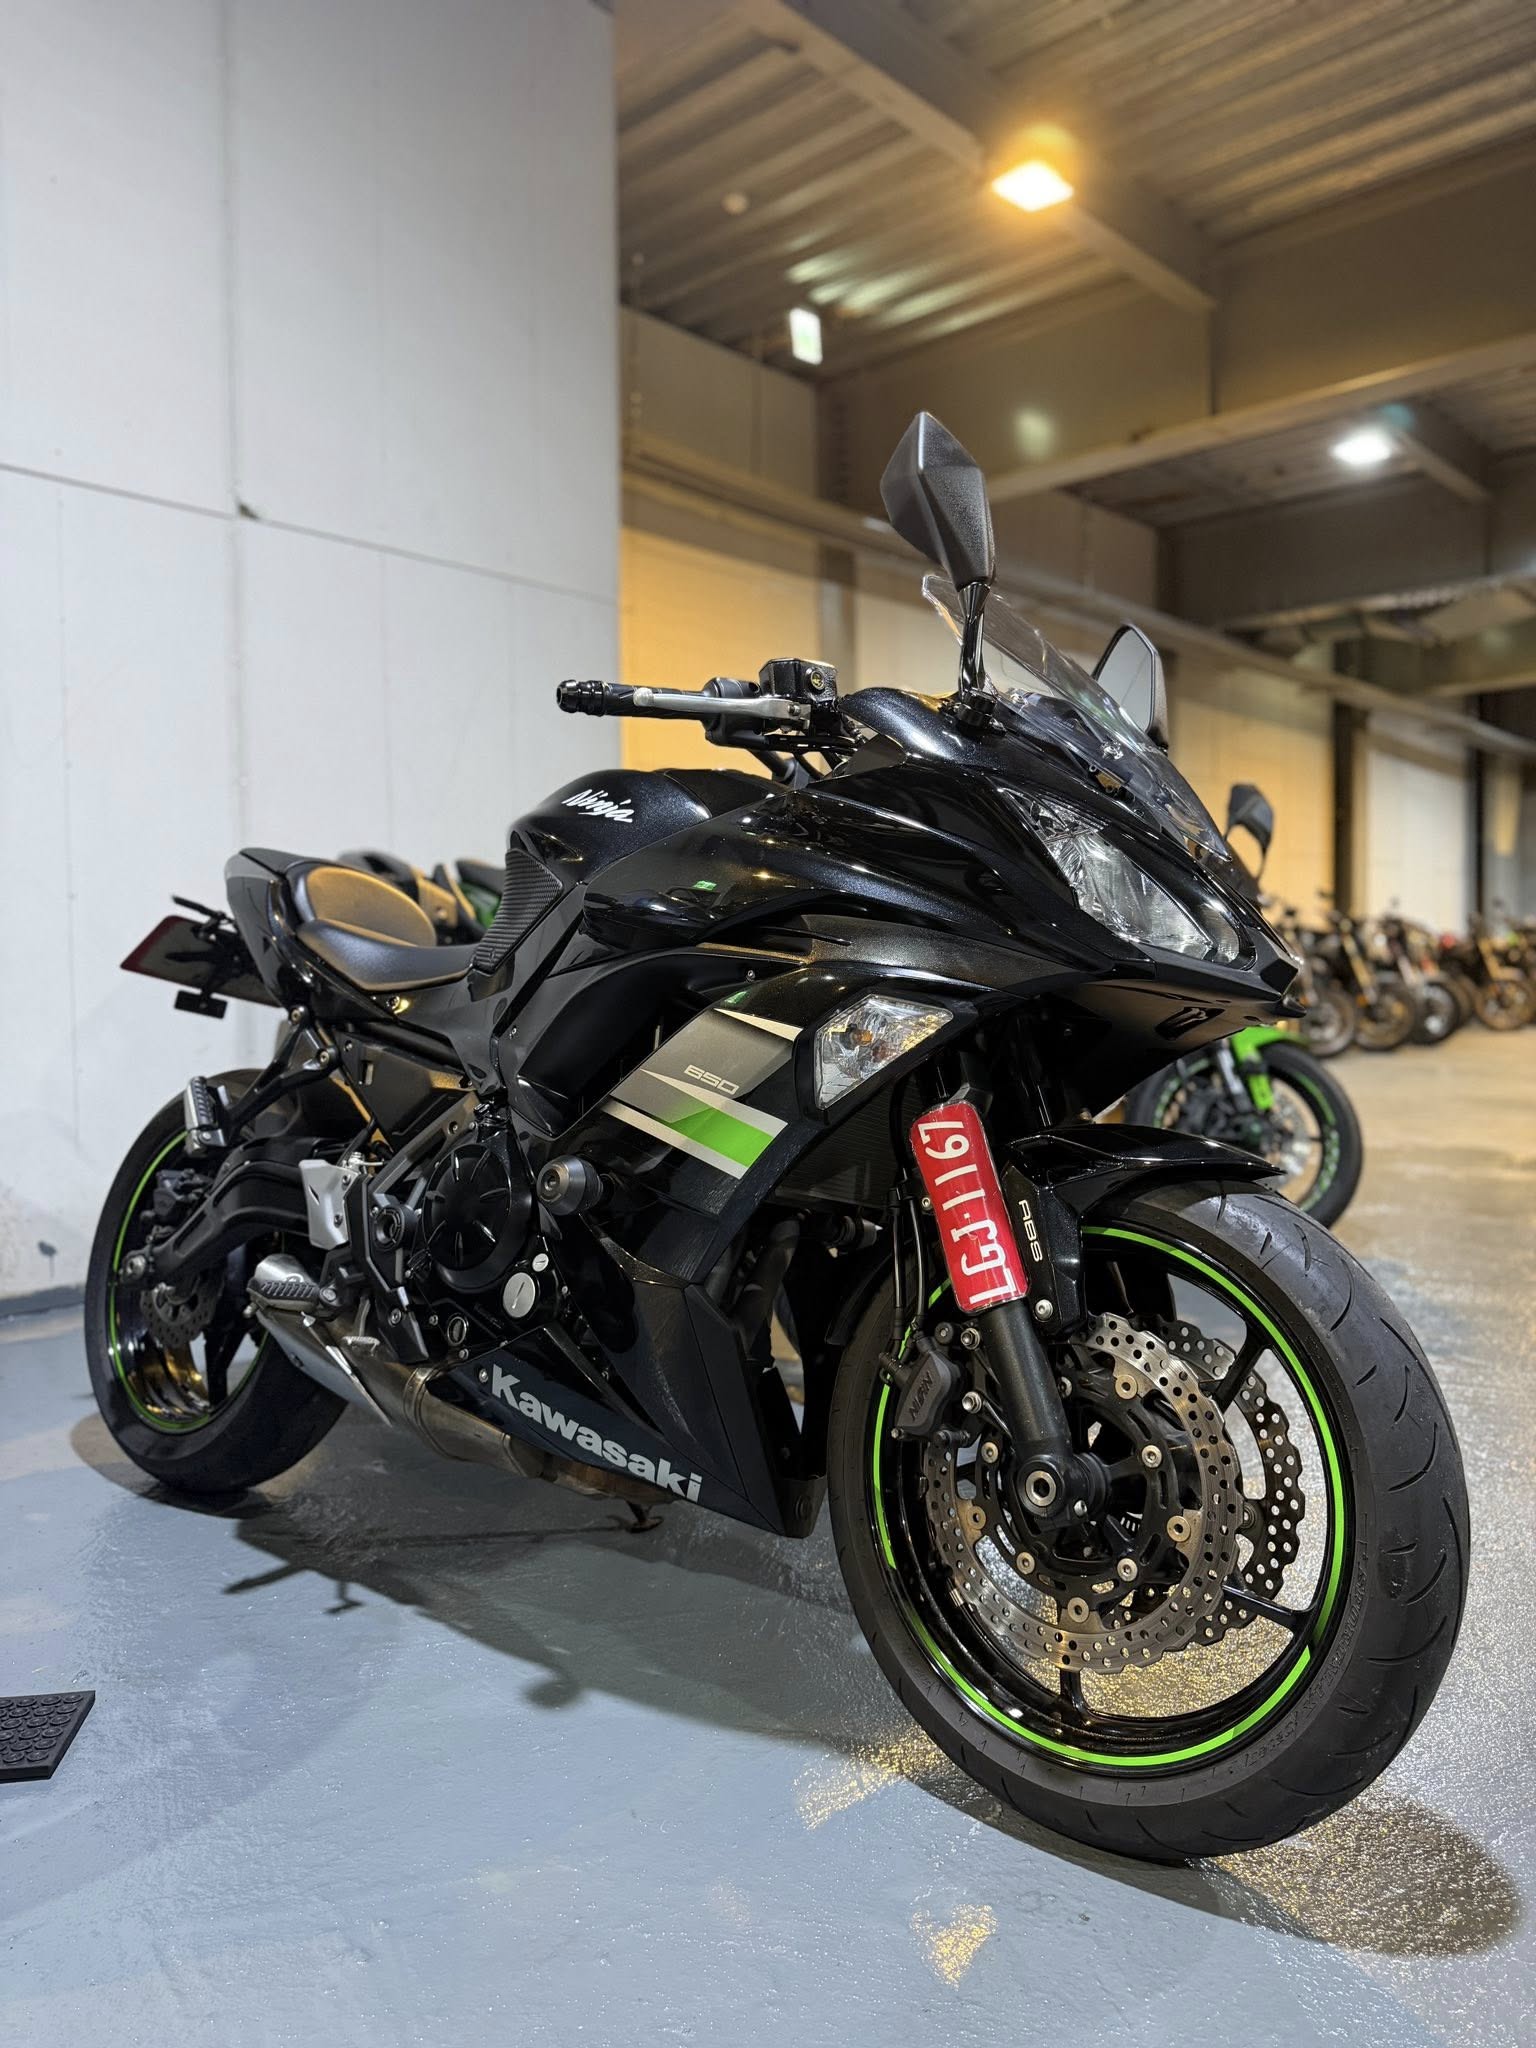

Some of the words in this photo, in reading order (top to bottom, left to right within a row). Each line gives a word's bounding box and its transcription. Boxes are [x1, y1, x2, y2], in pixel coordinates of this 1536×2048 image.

[561, 789, 635, 823] Ninja
[683, 1064, 740, 1095] 650
[1018, 1199, 1043, 1263] ABS
[491, 1363, 702, 1503] Kawasaki
